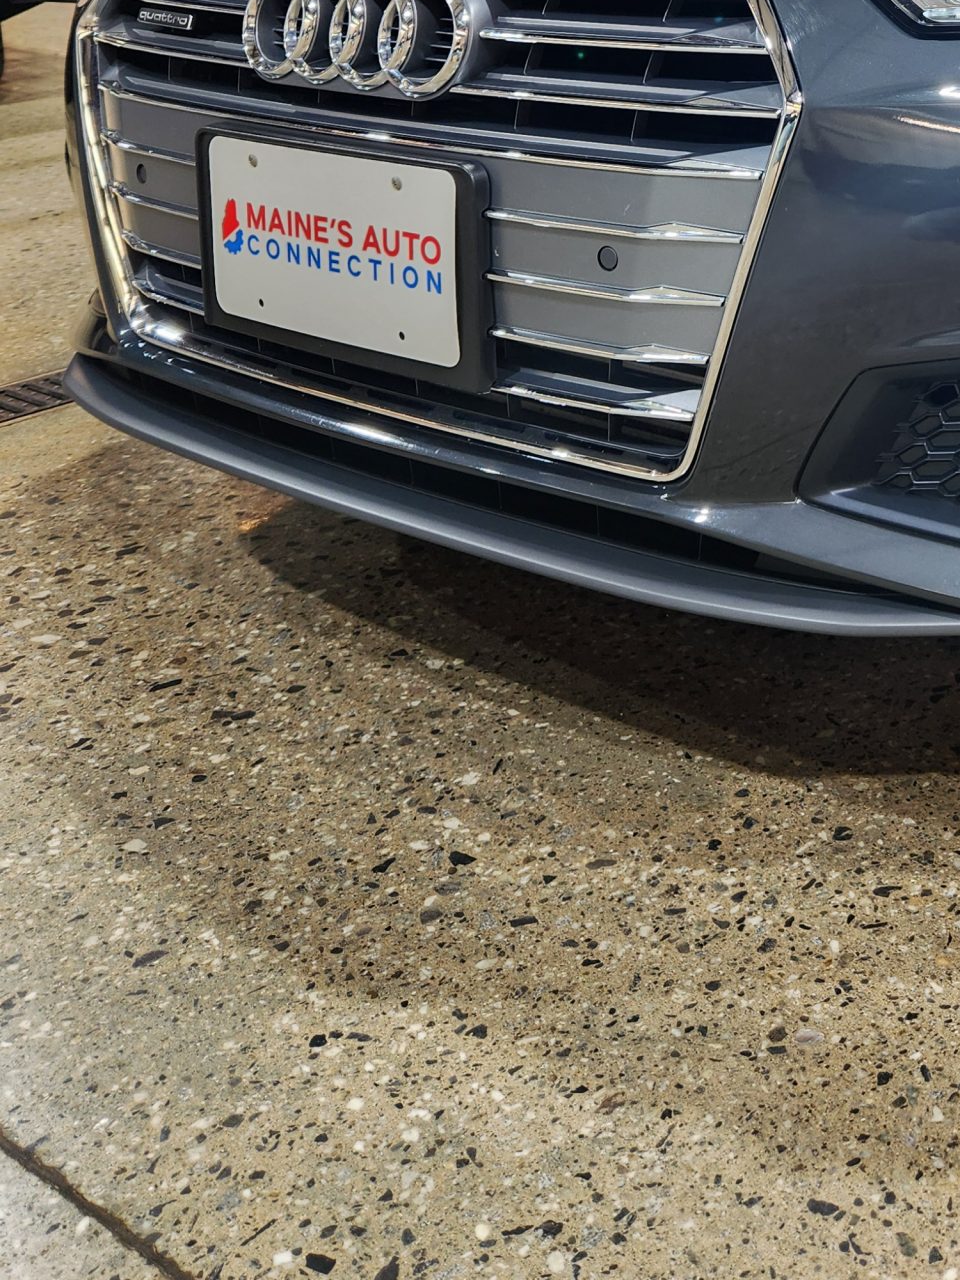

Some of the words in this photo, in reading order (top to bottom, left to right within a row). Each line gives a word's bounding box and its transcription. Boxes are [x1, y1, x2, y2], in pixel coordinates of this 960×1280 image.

[139, 11, 188, 25] quattro
[246, 202, 353, 248] MAINE'S
[362, 225, 442, 265] AUTO
[247, 234, 442, 294] CONNECTION
